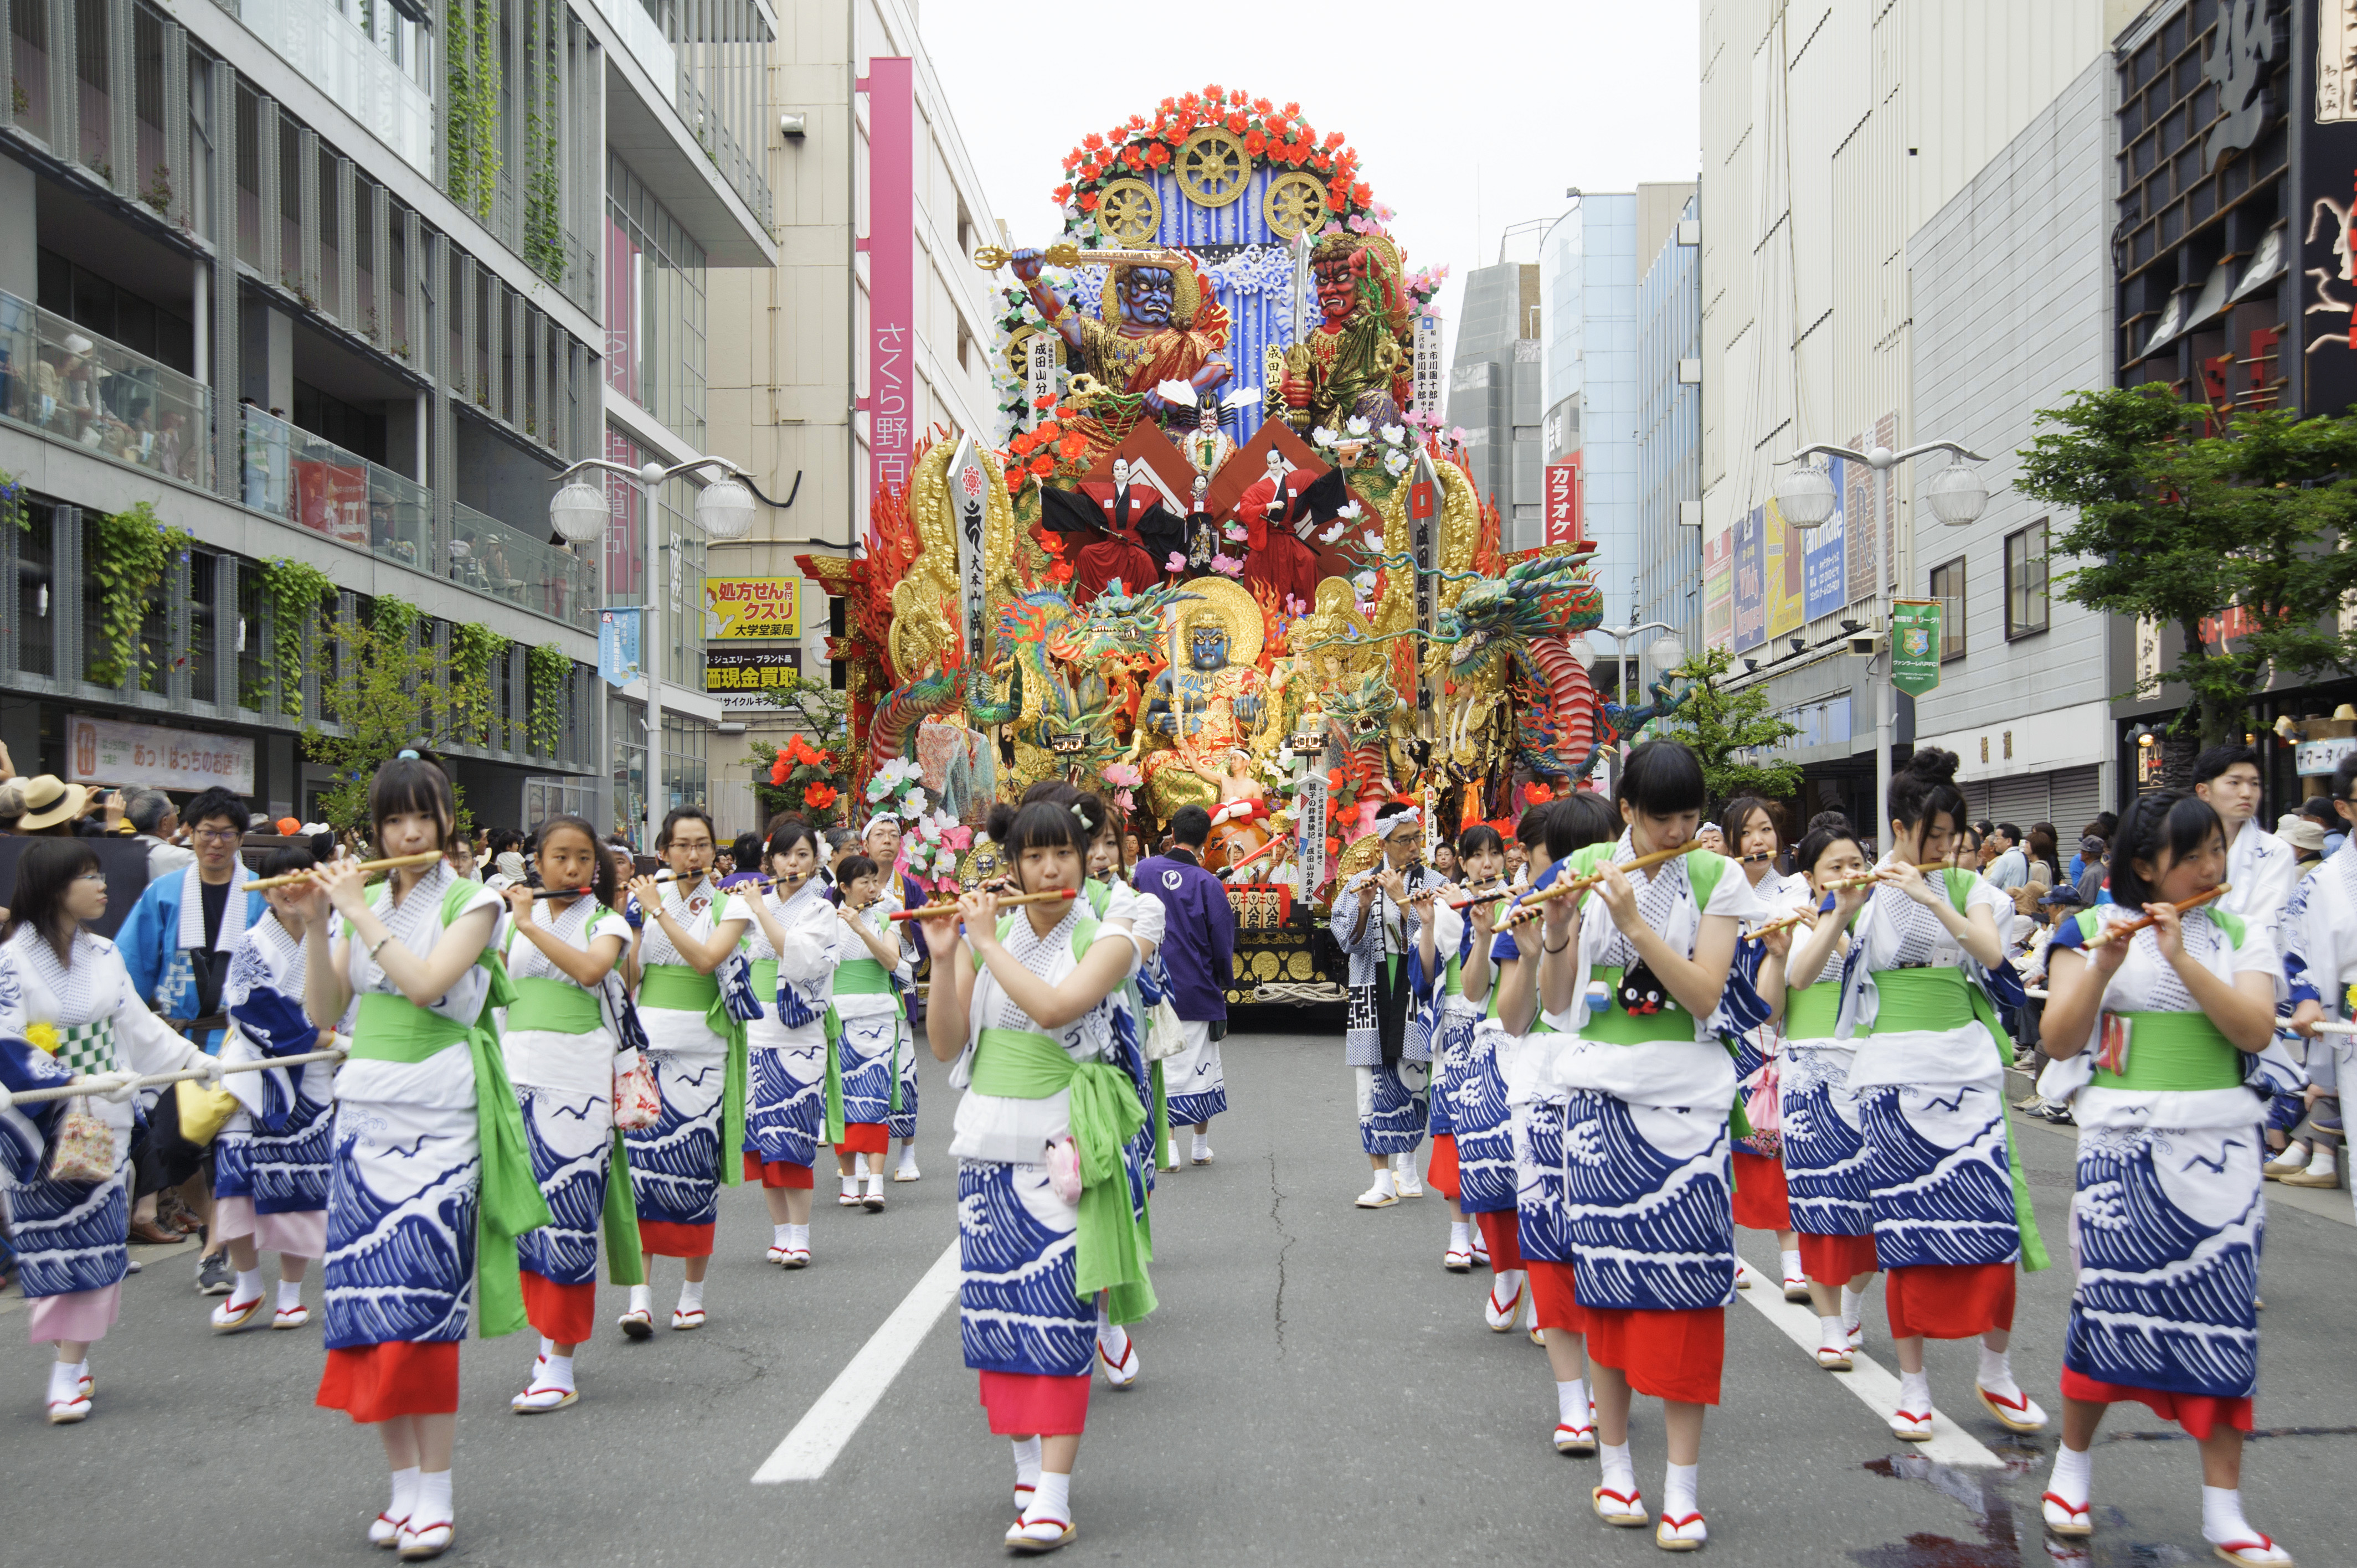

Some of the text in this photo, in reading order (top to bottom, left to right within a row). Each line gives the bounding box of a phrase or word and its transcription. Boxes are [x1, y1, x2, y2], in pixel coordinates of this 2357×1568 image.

[2324, 65, 2338, 111] わたみ
[1035, 343, 1047, 399] 成田山分
[1268, 345, 1281, 384] 成田山
[876, 323, 907, 497] さくら野百
[1551, 468, 1570, 546] カラオケ
[1805, 510, 1843, 556] animate
[719, 581, 793, 601] 処方せん 受付
[743, 602, 793, 621] クスリ
[969, 554, 984, 663] 大本山成田
[602, 612, 612, 622] 祝
[734, 624, 794, 636] 大学堂薬局
[2297, 746, 2349, 769] サマータイ
[1305, 847, 1315, 902] 成田山分身不動
